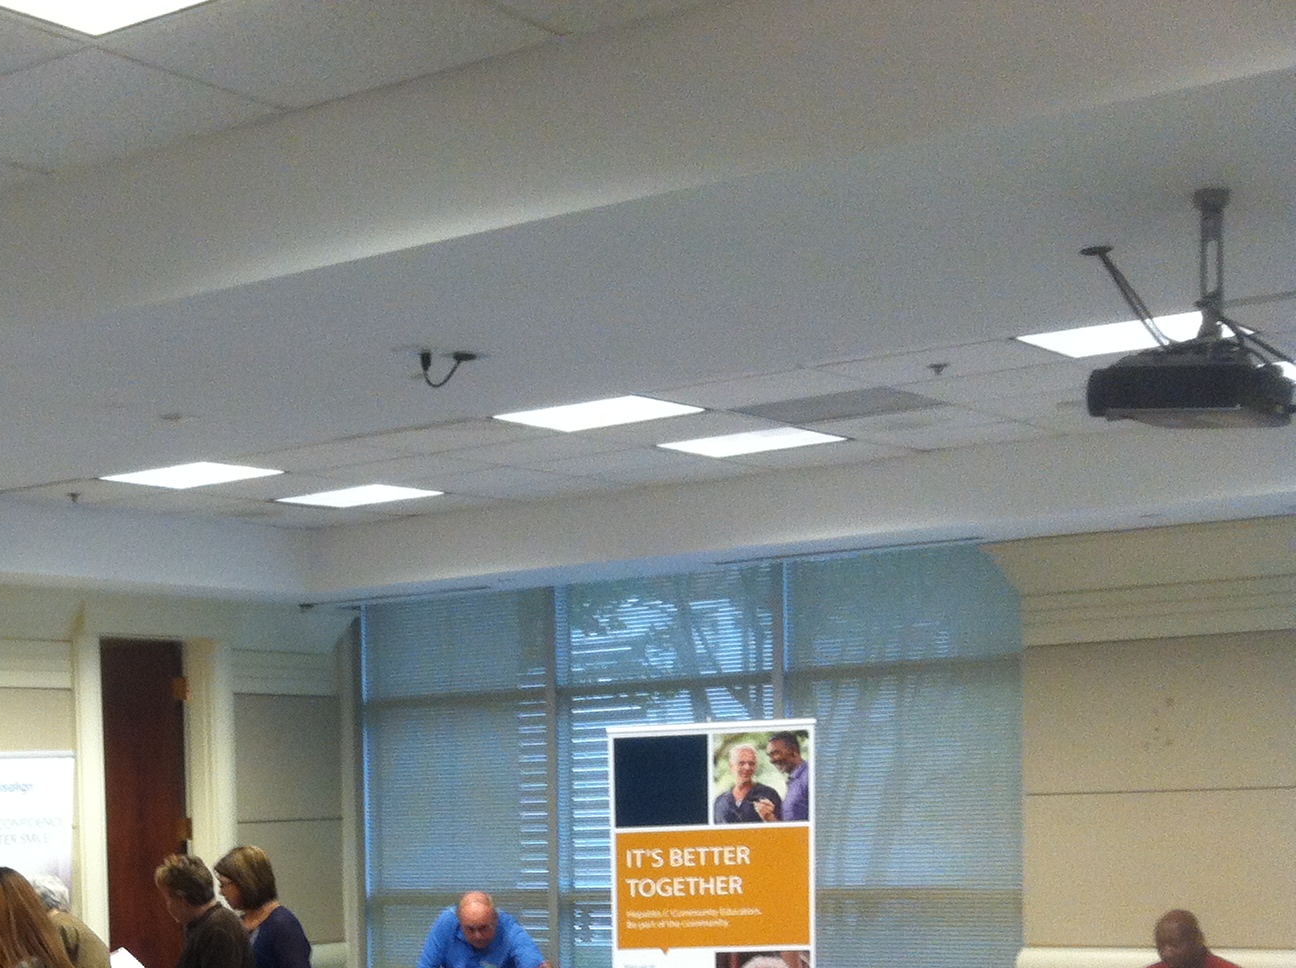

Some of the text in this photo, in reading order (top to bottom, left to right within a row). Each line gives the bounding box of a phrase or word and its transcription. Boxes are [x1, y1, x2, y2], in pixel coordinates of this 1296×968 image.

[625, 845, 751, 869] IT'S BETTER
[625, 875, 744, 898] TOGETHER
